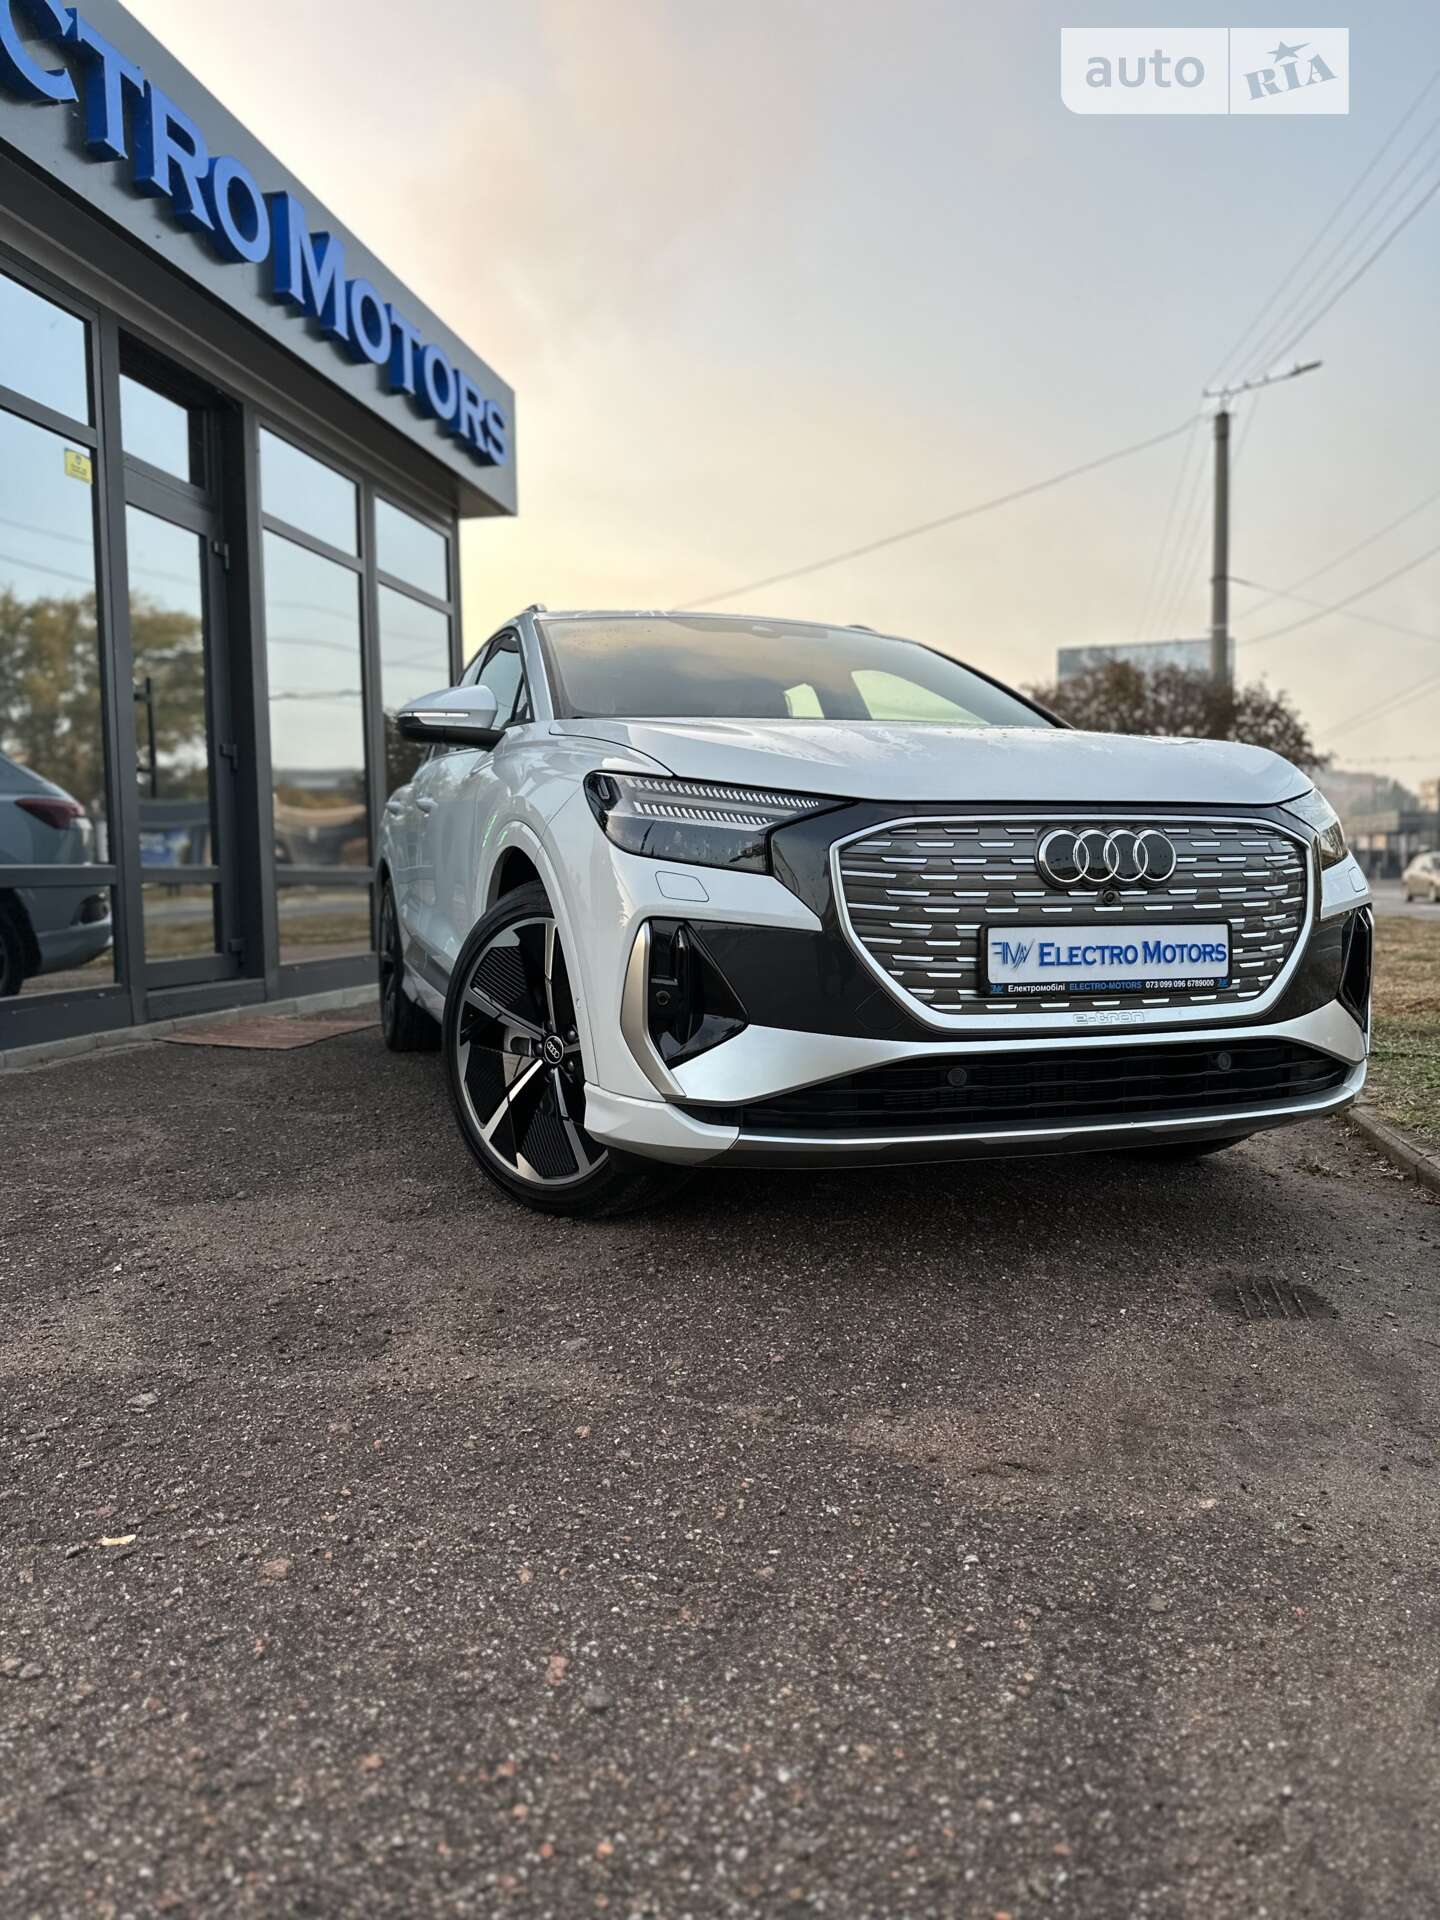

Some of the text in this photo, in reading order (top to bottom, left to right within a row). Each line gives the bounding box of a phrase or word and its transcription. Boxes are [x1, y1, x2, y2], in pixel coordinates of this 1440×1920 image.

[274, 190, 507, 466] MOTORS
[1039, 942, 1139, 966] ELECTRO
[1142, 940, 1226, 963] MOTORS
[1008, 984, 1065, 993] Електромобілі
[1069, 981, 1142, 991] ELECTRO-MOTORS
[1145, 981, 1159, 989] 073
[1160, 981, 1172, 989] 099
[1173, 980, 1186, 988] 096
[1187, 979, 1215, 987] 6789000
[1073, 1011, 1145, 1024] e-tron
